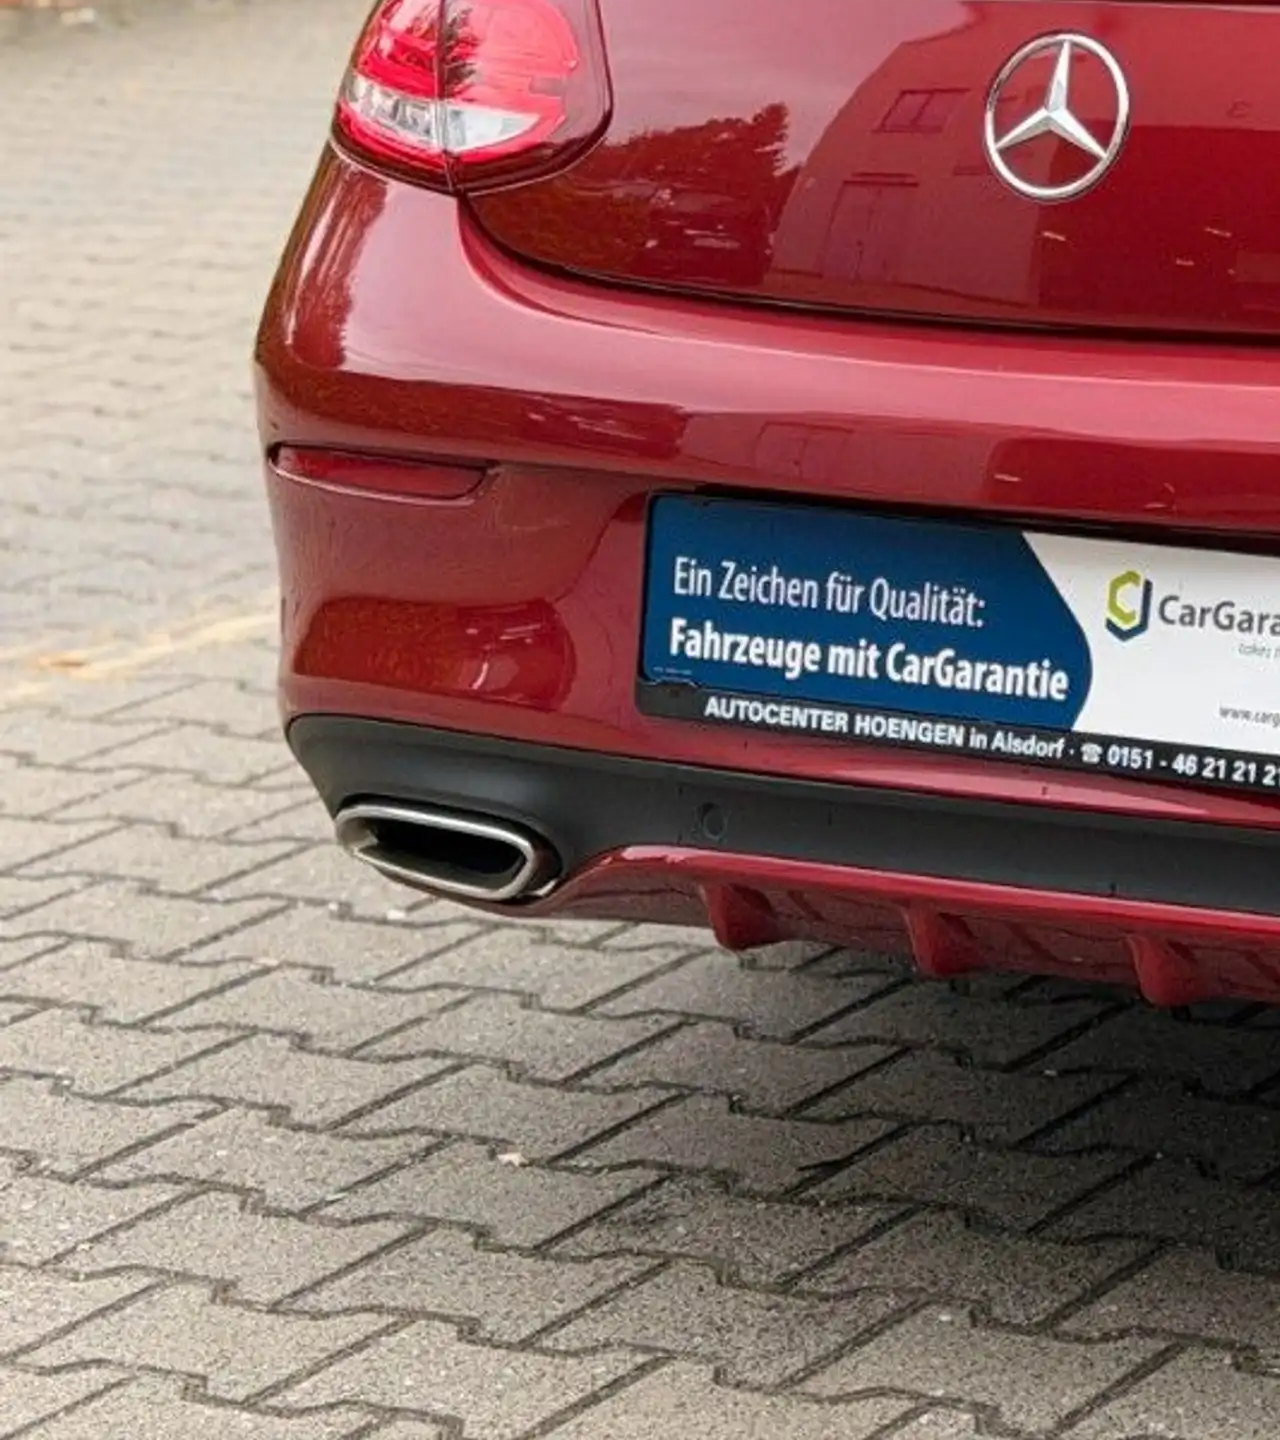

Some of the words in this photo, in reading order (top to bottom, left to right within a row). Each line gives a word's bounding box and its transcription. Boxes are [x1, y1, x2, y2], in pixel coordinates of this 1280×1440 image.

[674, 556, 712, 597] Ein
[718, 560, 819, 609] Zeichen
[826, 571, 865, 614] für
[870, 576, 986, 628] Qualität:
[669, 617, 822, 680] Fahrzeuge
[827, 638, 880, 679] mit
[886, 642, 1069, 701] CarGarantie
[704, 695, 849, 733] AUTOCENTER
[854, 712, 965, 747] HOENGEN
[969, 726, 988, 750] in
[991, 730, 1066, 759] Alsdorf
[1107, 744, 1154, 770] 0151
[1172, 753, 1198, 776] 46
[1202, 756, 1226, 780] 21
[1231, 760, 1256, 784] 21
